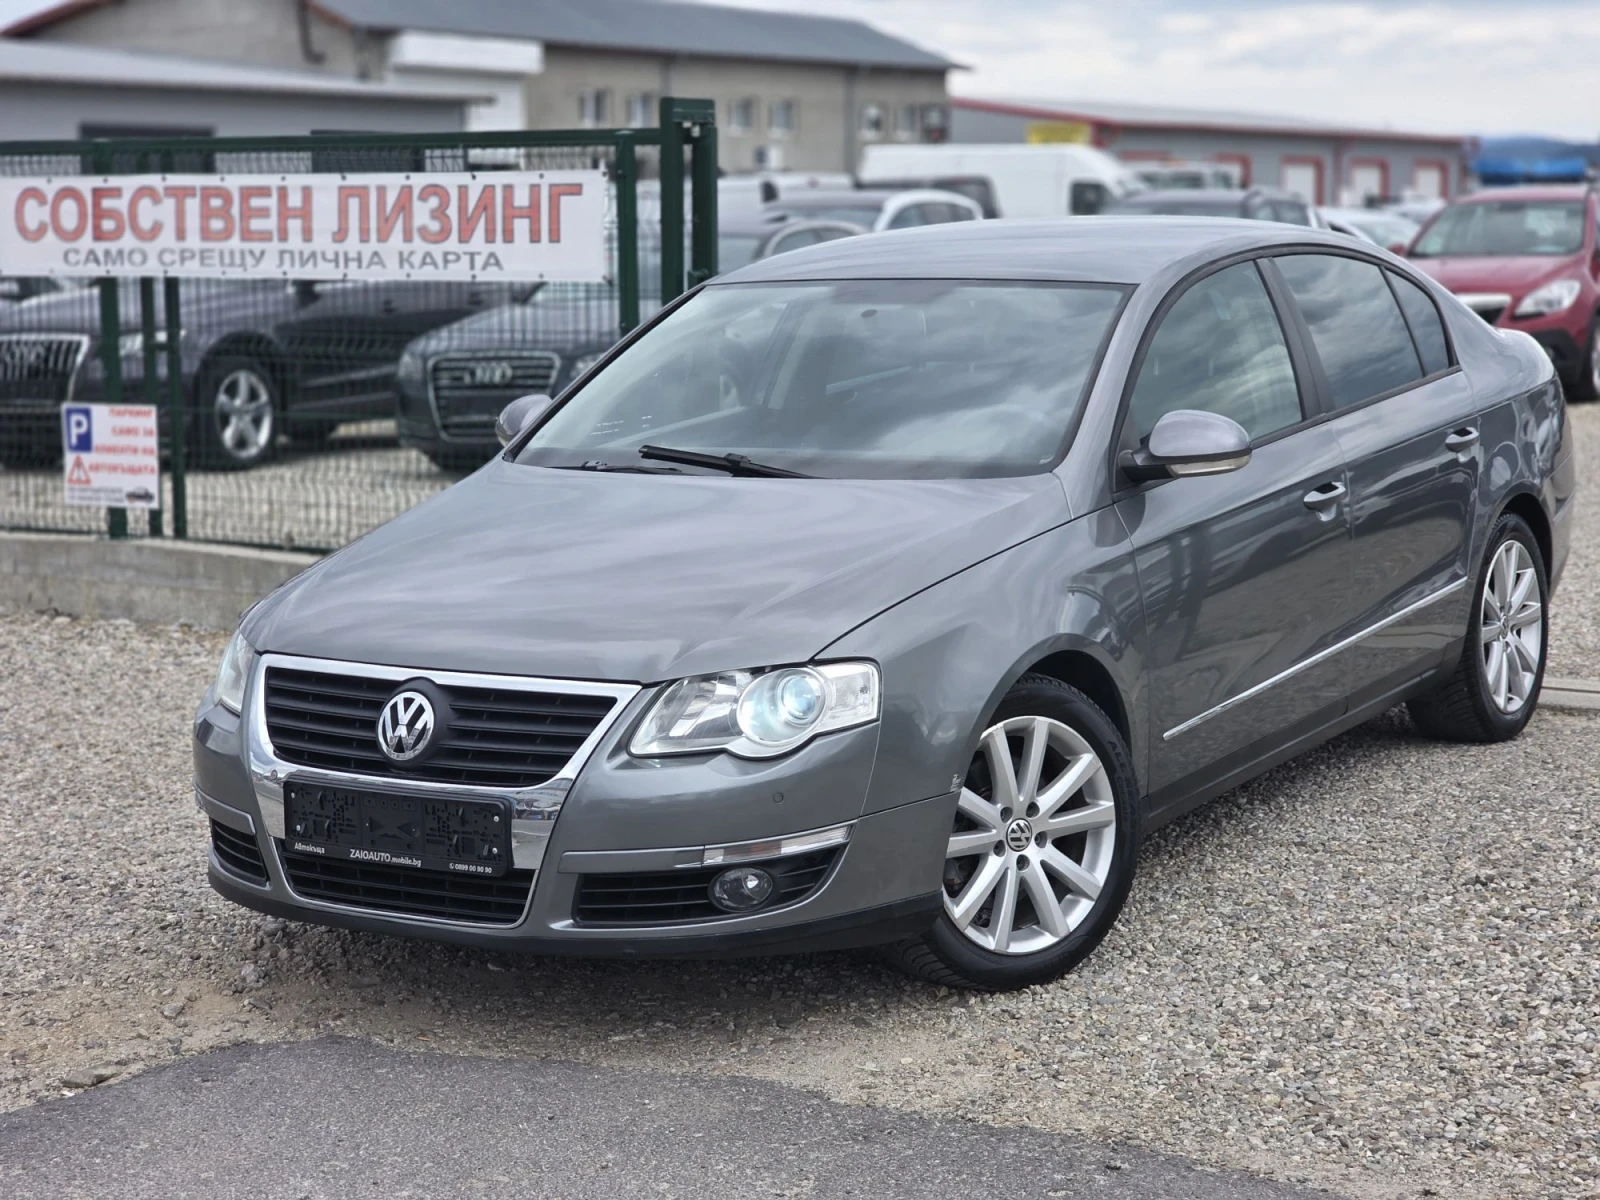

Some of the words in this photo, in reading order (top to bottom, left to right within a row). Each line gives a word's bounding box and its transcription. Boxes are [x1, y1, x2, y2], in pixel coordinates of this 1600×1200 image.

[14, 185, 313, 243] СОБСТВЕН
[332, 183, 583, 243] ЛИЗИНГ
[63, 248, 148, 267] САМО
[157, 248, 265, 272] СРЕЩУ
[276, 249, 387, 270] ЛИЧНА
[398, 250, 504, 271] КАРТА
[109, 407, 153, 417] ПАРКИНГ
